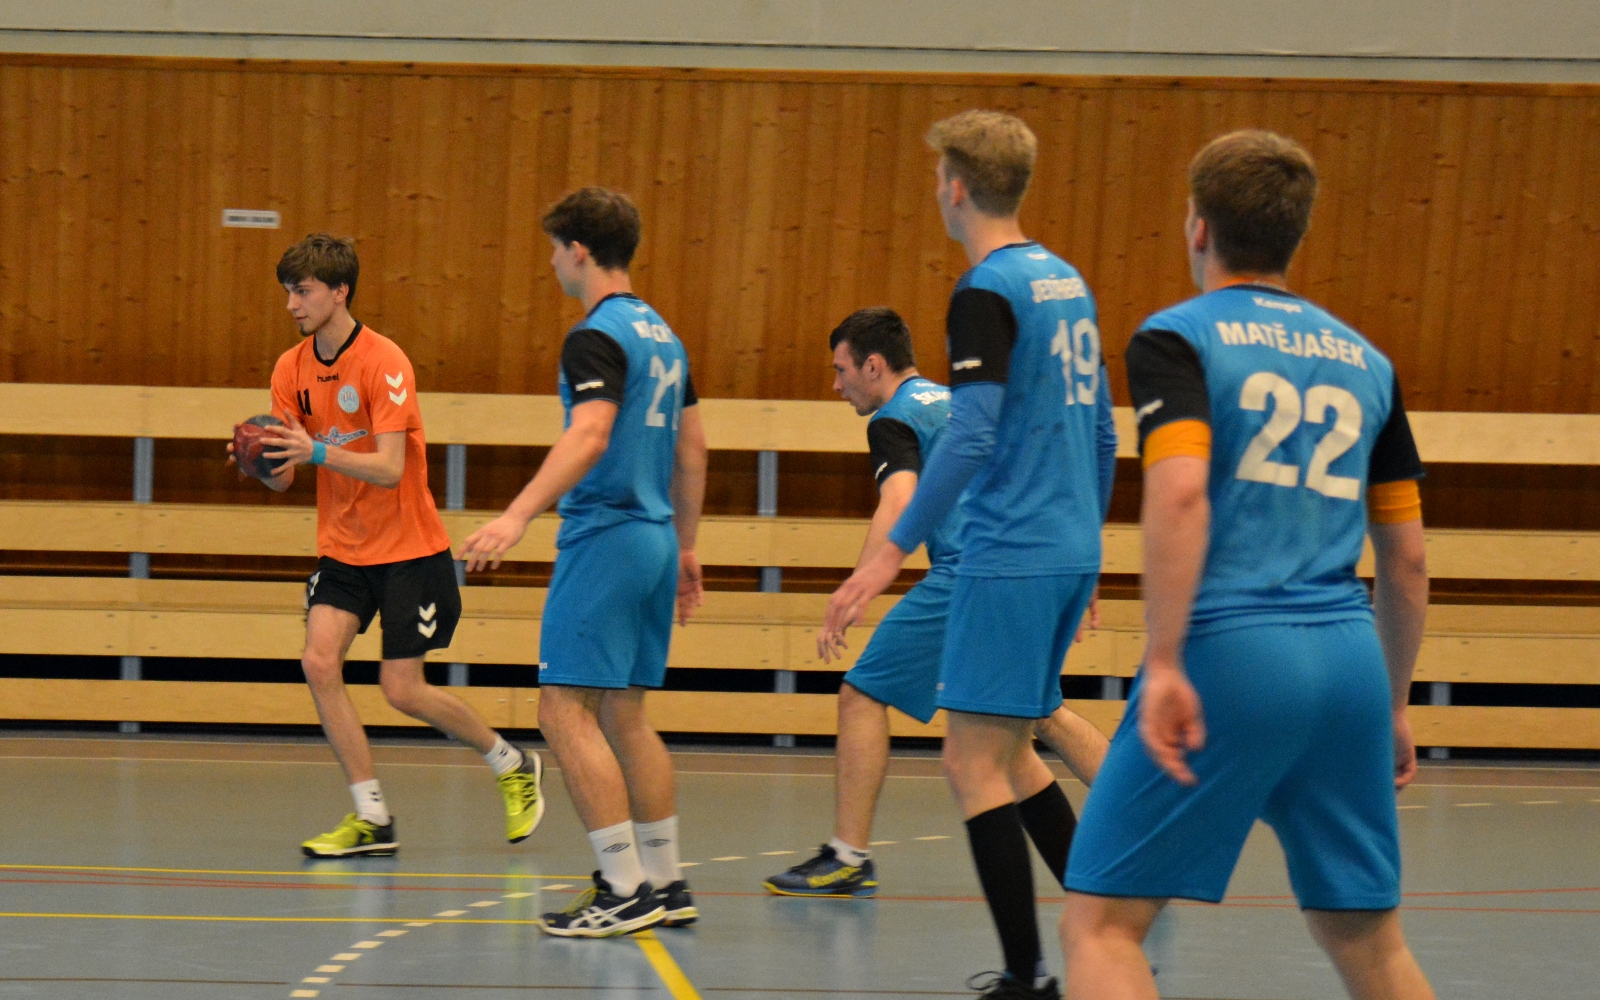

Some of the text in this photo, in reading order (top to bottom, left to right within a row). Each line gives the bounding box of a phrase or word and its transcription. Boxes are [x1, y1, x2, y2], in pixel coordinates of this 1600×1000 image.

[1050, 318, 1101, 406] 19
[1216, 321, 1368, 371] MATĚJAŠEK
[645, 355, 682, 431] 21
[1235, 371, 1363, 501] 22
